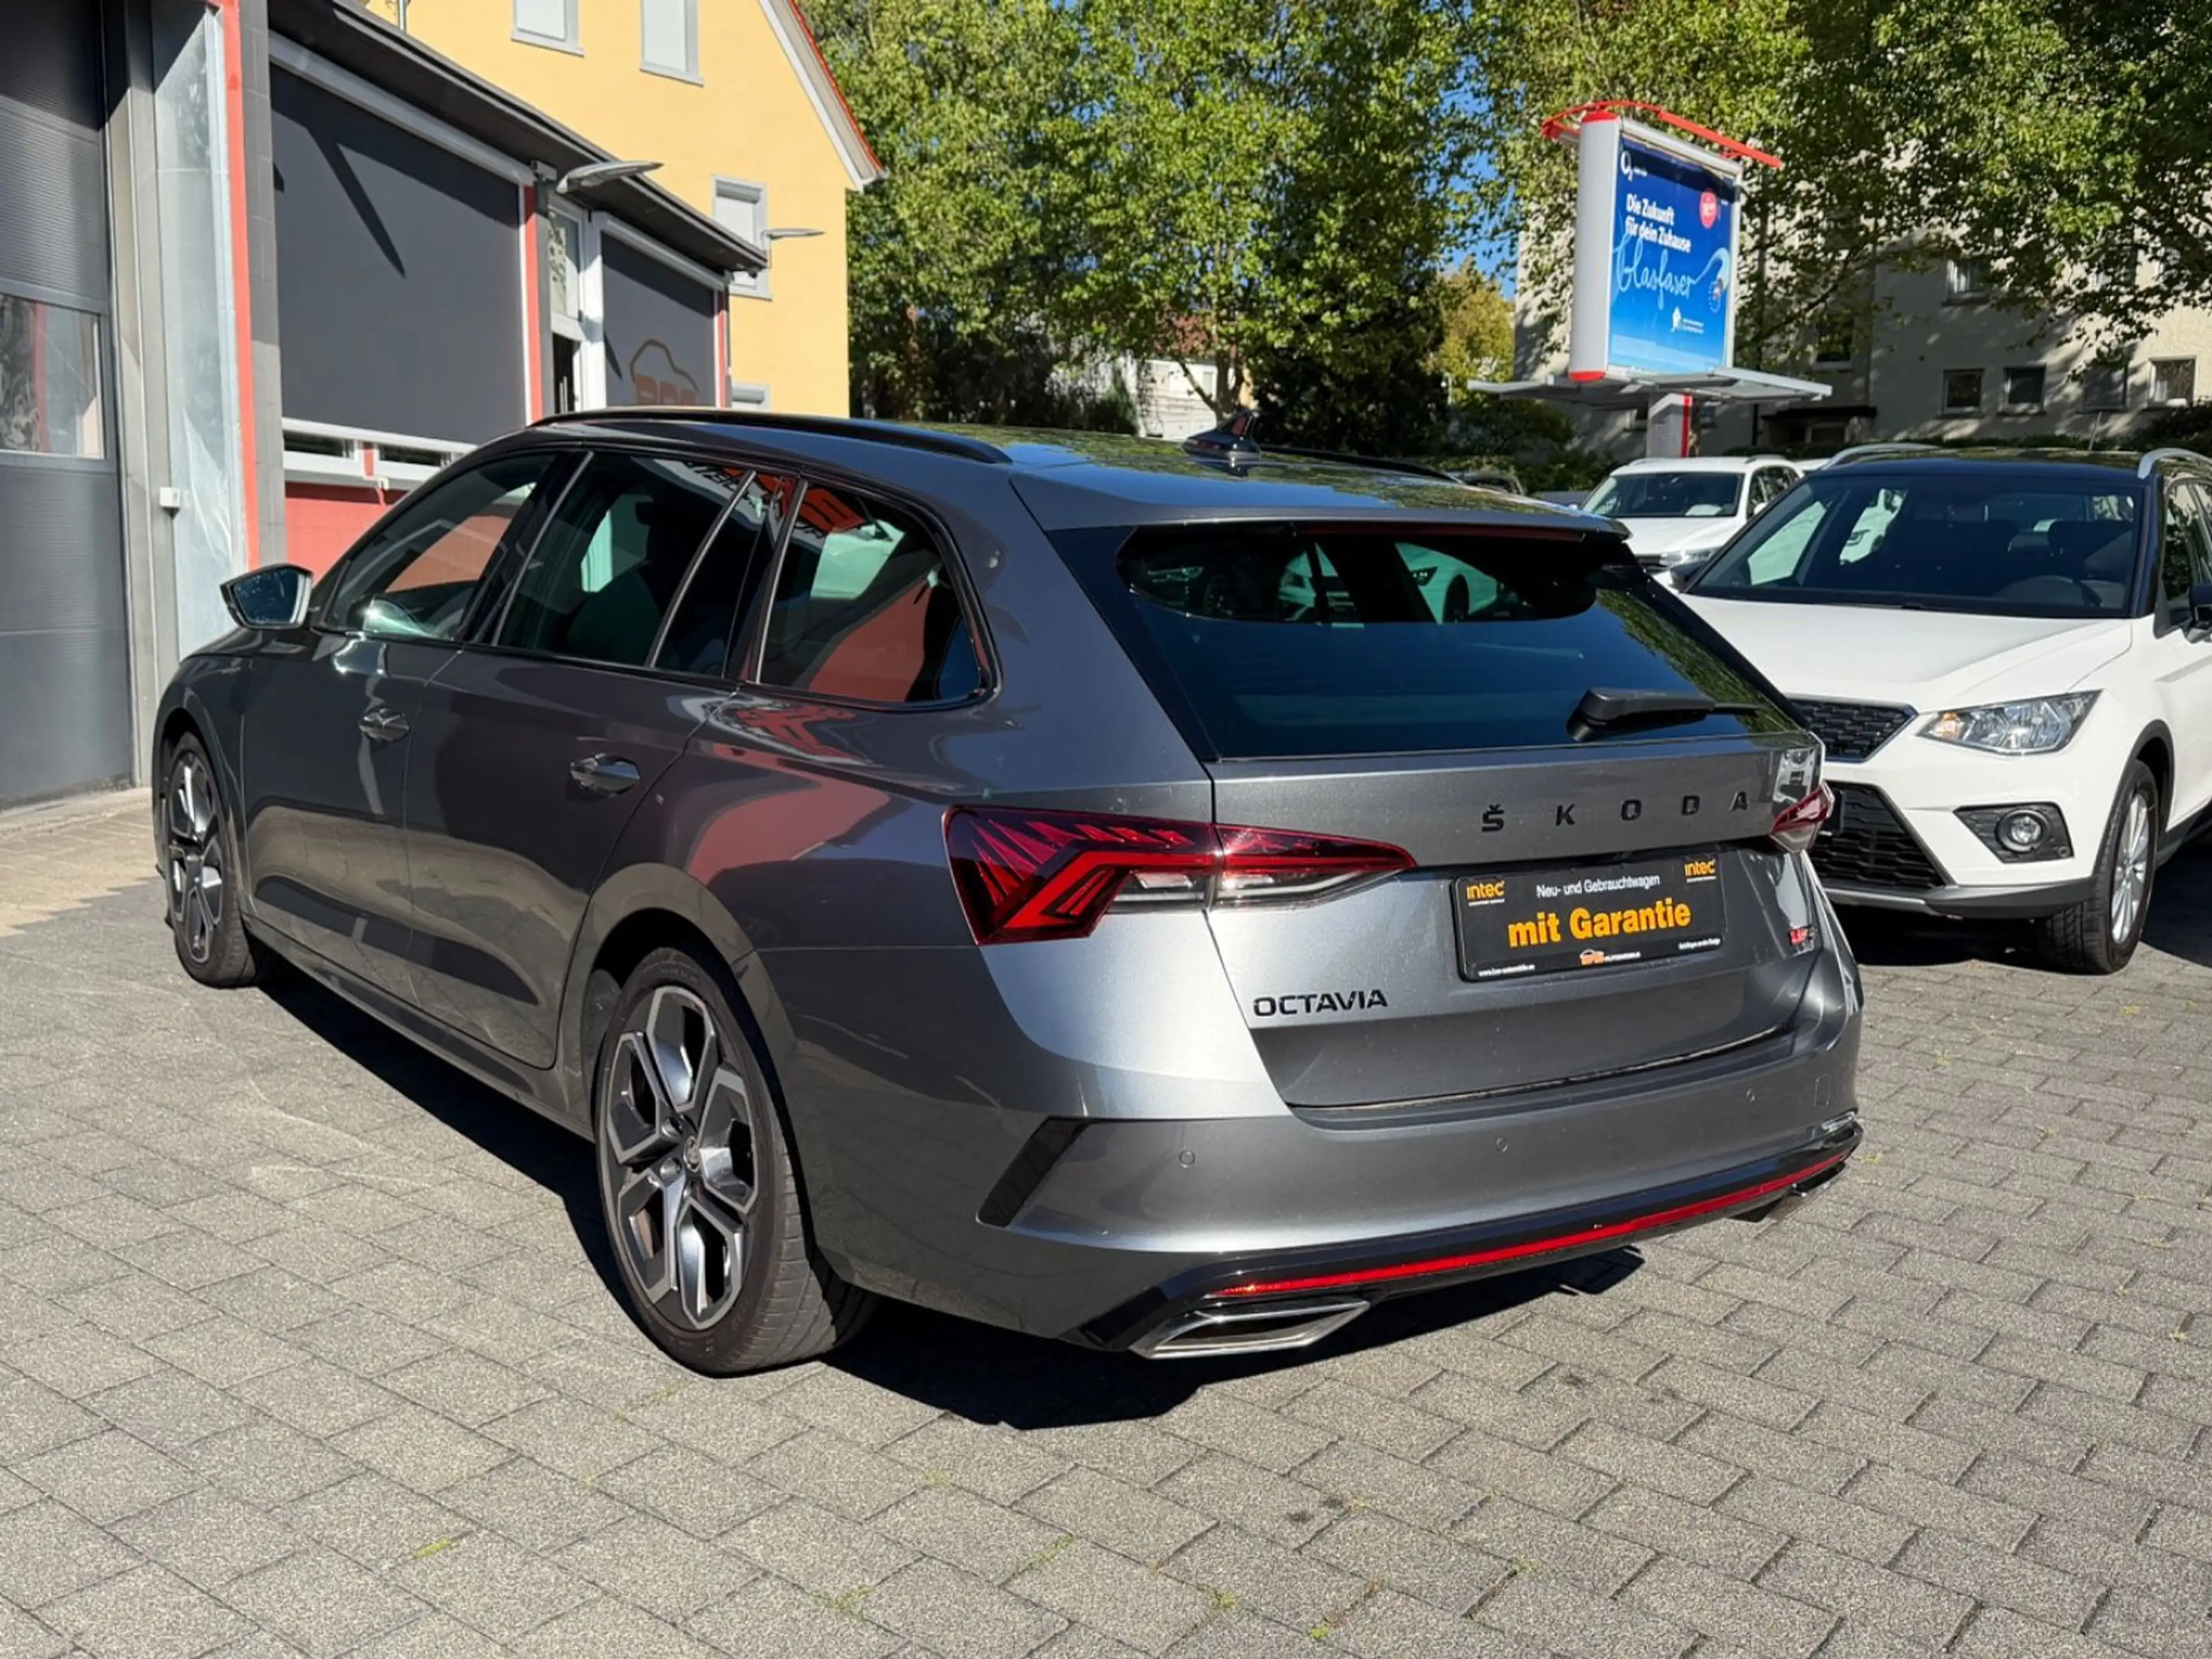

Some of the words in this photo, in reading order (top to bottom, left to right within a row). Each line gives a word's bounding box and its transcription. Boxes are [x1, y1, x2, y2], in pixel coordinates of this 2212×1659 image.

[1626, 193, 1641, 215] Die
[1642, 198, 1674, 226] Zukunft
[1625, 215, 1638, 236] für
[1639, 220, 1658, 243] dein
[1658, 226, 1691, 253] Zuhause
[1615, 232, 1696, 310] Glasfaser
[1481, 791, 1748, 833] ŠKODA
[1684, 860, 1715, 877] intec
[1467, 880, 1505, 900] intec
[1536, 884, 1561, 898] Neu-
[1563, 881, 1582, 895] und
[1584, 875, 1660, 893] Gebrauchtwagen
[1508, 911, 1561, 948] mit
[1569, 897, 1692, 940] Garantie
[1253, 988, 1388, 1017] OCTAVIA
